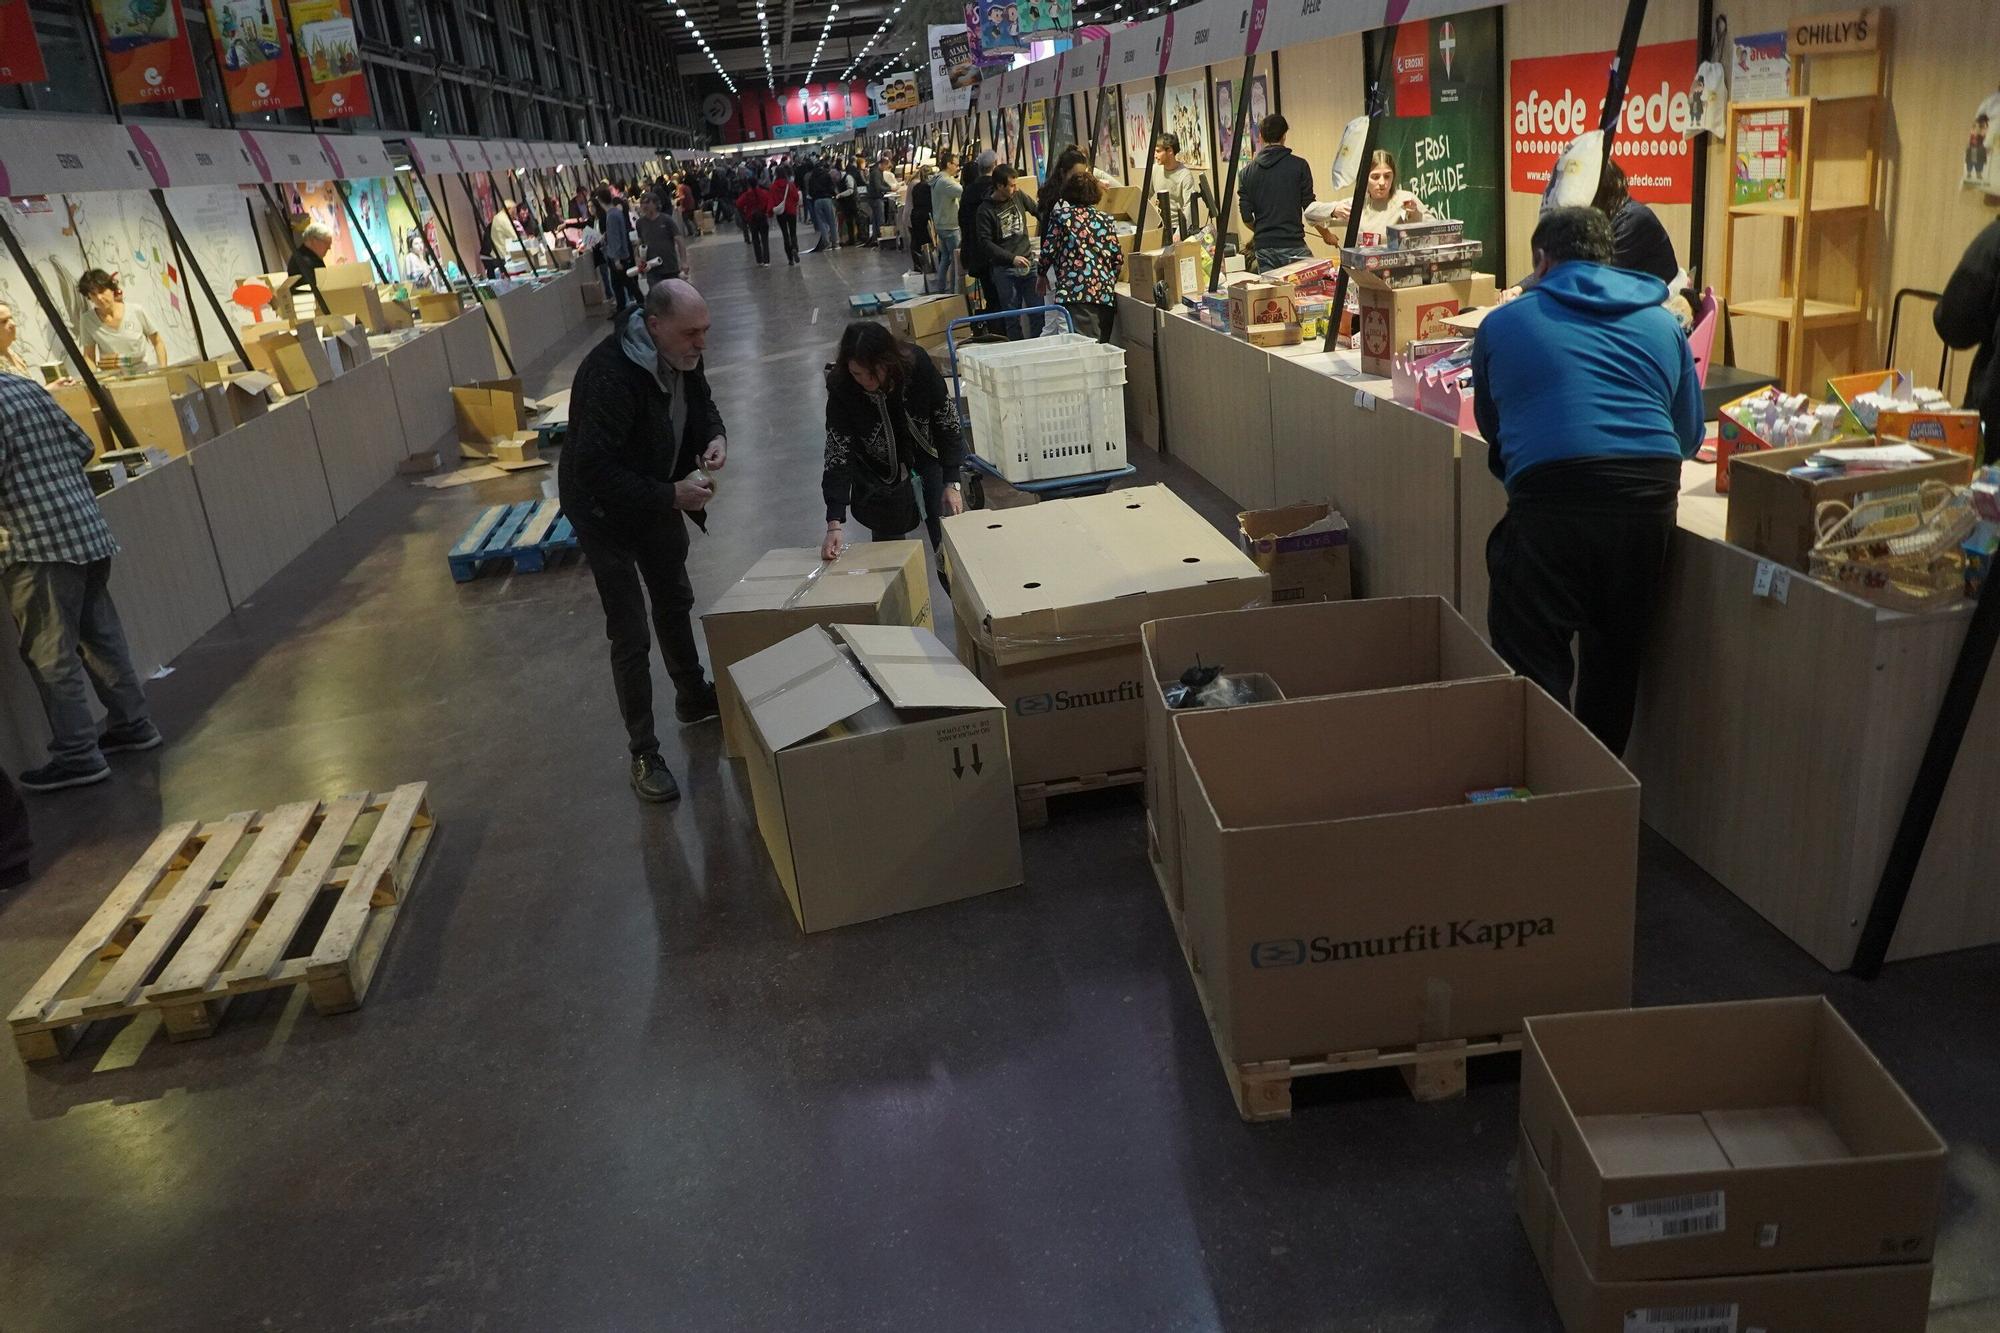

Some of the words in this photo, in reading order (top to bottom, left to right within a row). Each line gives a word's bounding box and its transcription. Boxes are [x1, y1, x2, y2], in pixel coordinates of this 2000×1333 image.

[1254, 9, 1265, 30] 52
[1796, 19, 1868, 46] CHILLY'S
[1194, 28, 1210, 46] EROSKI
[1404, 57, 1424, 70] EROSKI
[1515, 88, 1587, 135] afede
[1599, 80, 1691, 134] fede
[1415, 134, 1450, 169] EROSI
[1409, 162, 1468, 200] BAZKIDE
[1526, 169, 1552, 182] www.afe
[1447, 223, 1464, 233] 1000
[1256, 311, 1289, 324] BORRAS
[1055, 681, 1145, 711] Smurfit
[1309, 924, 1441, 964] Smurfit
[1447, 916, 1556, 950] Kappa
